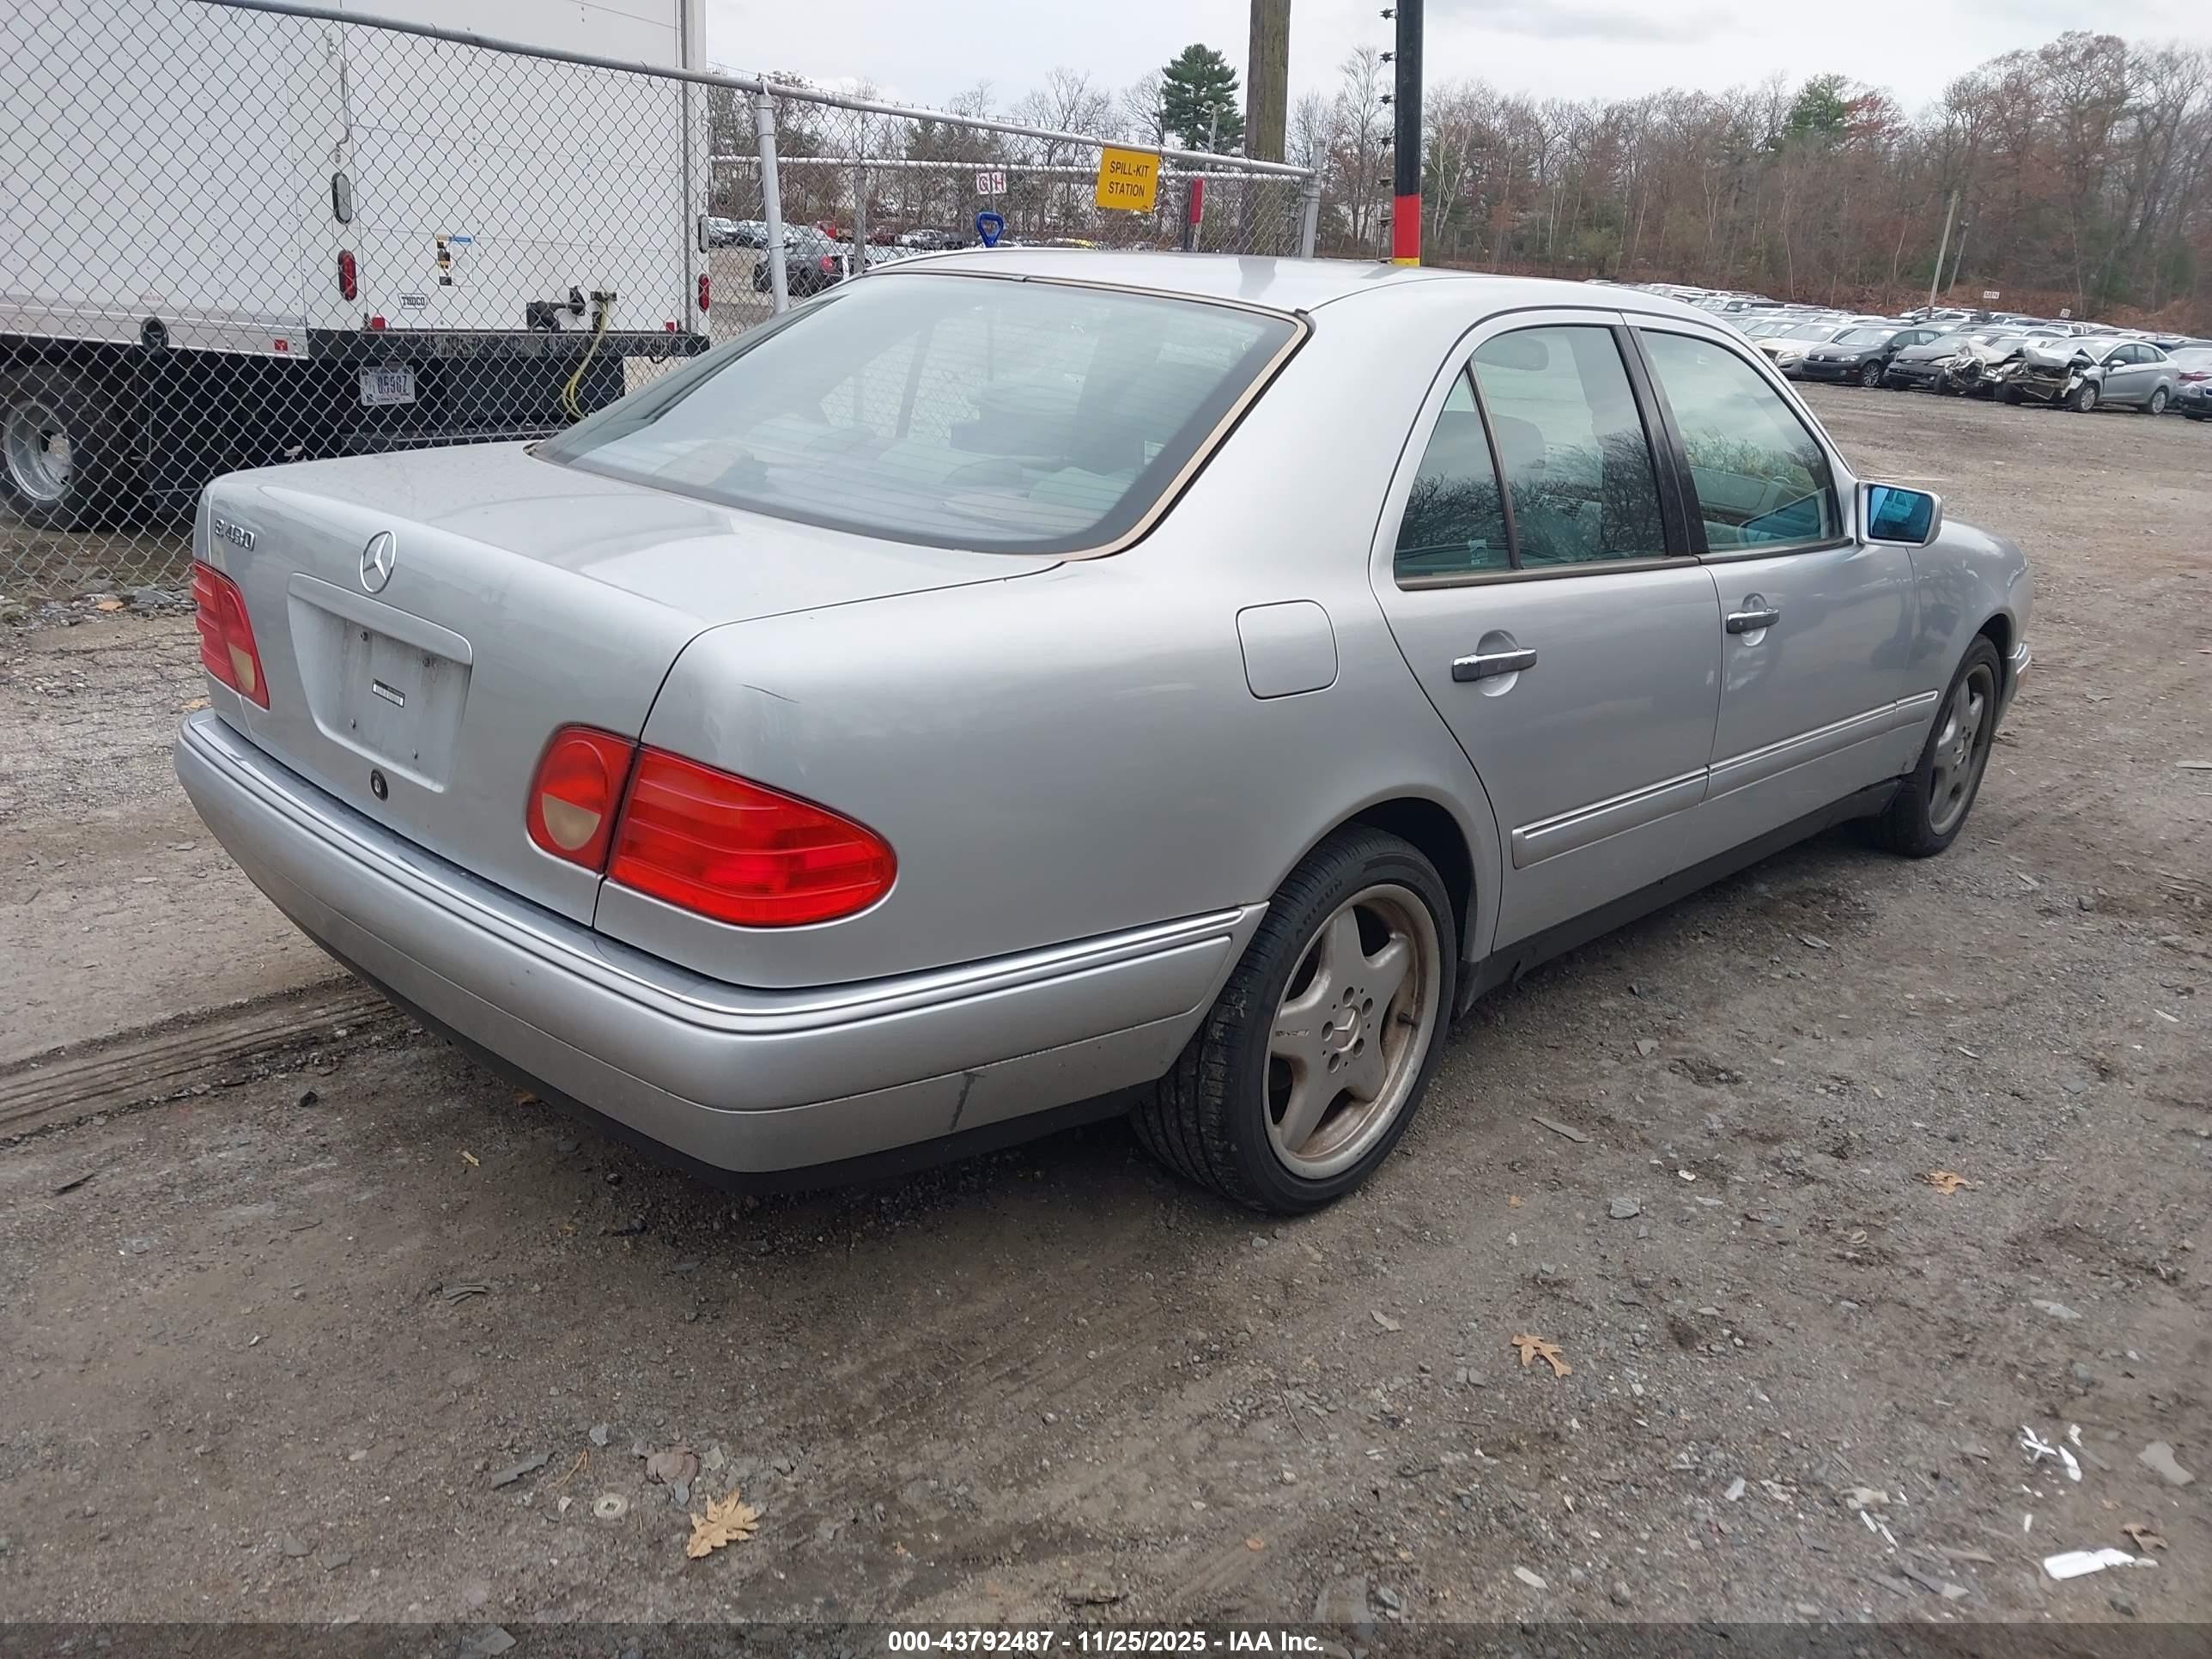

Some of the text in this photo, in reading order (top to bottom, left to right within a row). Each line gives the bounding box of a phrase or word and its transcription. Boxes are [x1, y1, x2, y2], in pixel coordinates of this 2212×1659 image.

[1109, 161, 1150, 177] SPILL-KIT
[1108, 181, 1146, 198] STATION
[226, 524, 256, 551] 430
